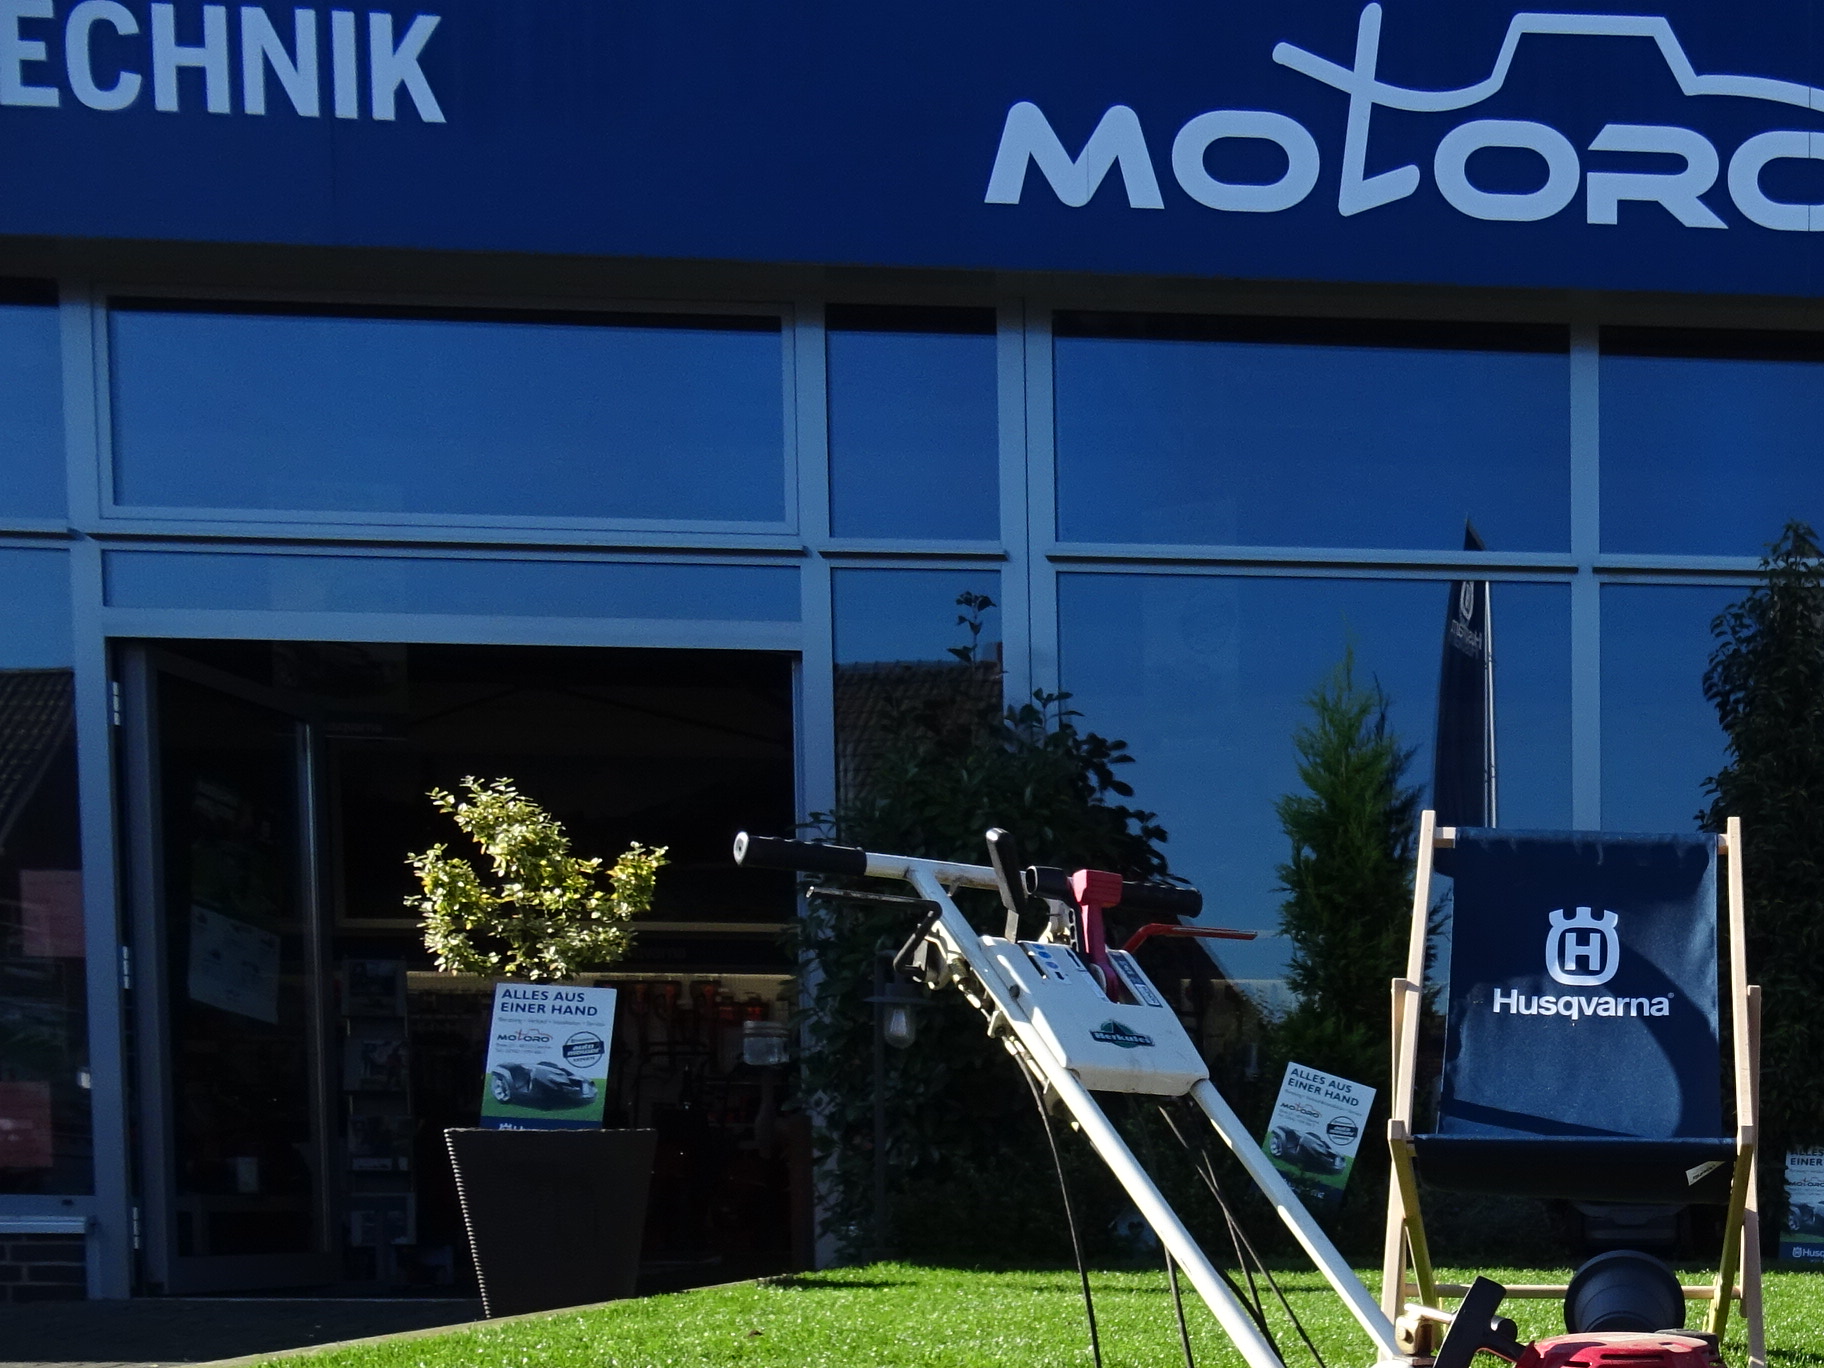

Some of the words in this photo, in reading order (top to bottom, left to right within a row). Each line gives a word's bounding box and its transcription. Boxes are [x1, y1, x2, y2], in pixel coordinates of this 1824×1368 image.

[0, 0, 447, 124] ECHNIK
[501, 988, 549, 1001] ALLES
[553, 991, 585, 1003] AUS
[500, 1002, 546, 1015] EINER
[551, 1004, 598, 1017] HAND
[1494, 988, 1670, 1020] Husqvarna
[497, 1028, 552, 1043] MOTORO
[1290, 1067, 1327, 1085] ALLES
[1328, 1080, 1353, 1094] AUS
[1287, 1077, 1322, 1096] EINER
[1324, 1089, 1360, 1108] HAND
[1791, 1148, 1824, 1158] ALLES
[1790, 1157, 1823, 1167] EINER
